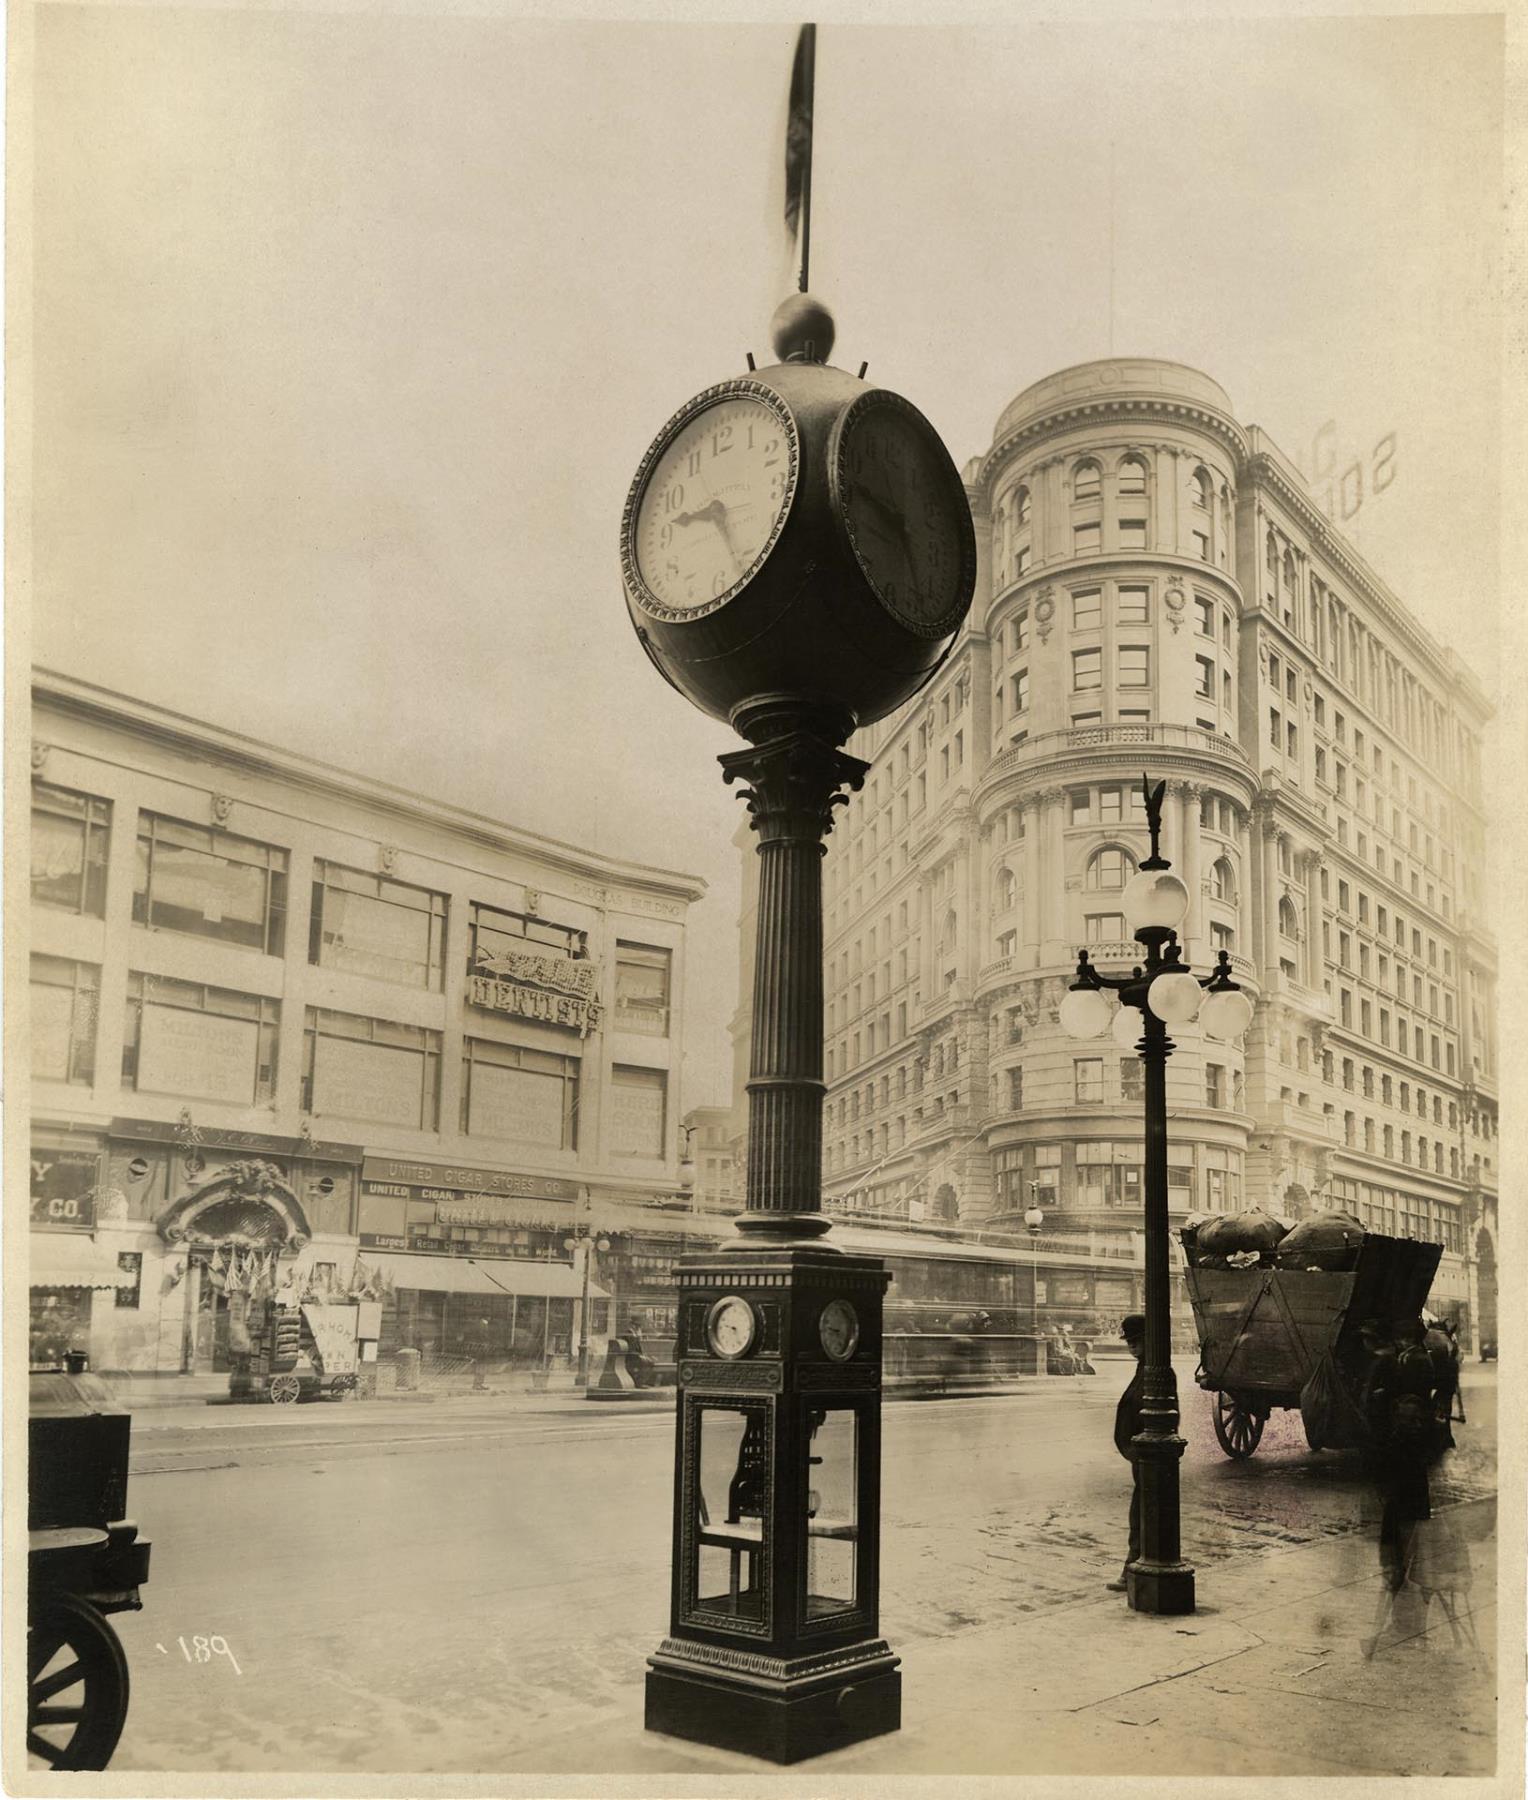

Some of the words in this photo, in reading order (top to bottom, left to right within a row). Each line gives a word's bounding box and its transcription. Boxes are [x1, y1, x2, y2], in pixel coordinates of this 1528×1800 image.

[711, 425, 735, 457] 12
[763, 439, 779, 468] 2
[687, 449, 701, 478] 11
[663, 483, 684, 514] 10
[631, 897, 680, 917] BUILDING
[473, 977, 602, 1032] DENTISTS
[369, 1184, 408, 1197] UNITED
[389, 1163, 433, 1180] UNITED
[444, 1169, 482, 1186] CIGAR
[492, 1176, 535, 1192] STORES
[49, 1198, 83, 1218] CO.
